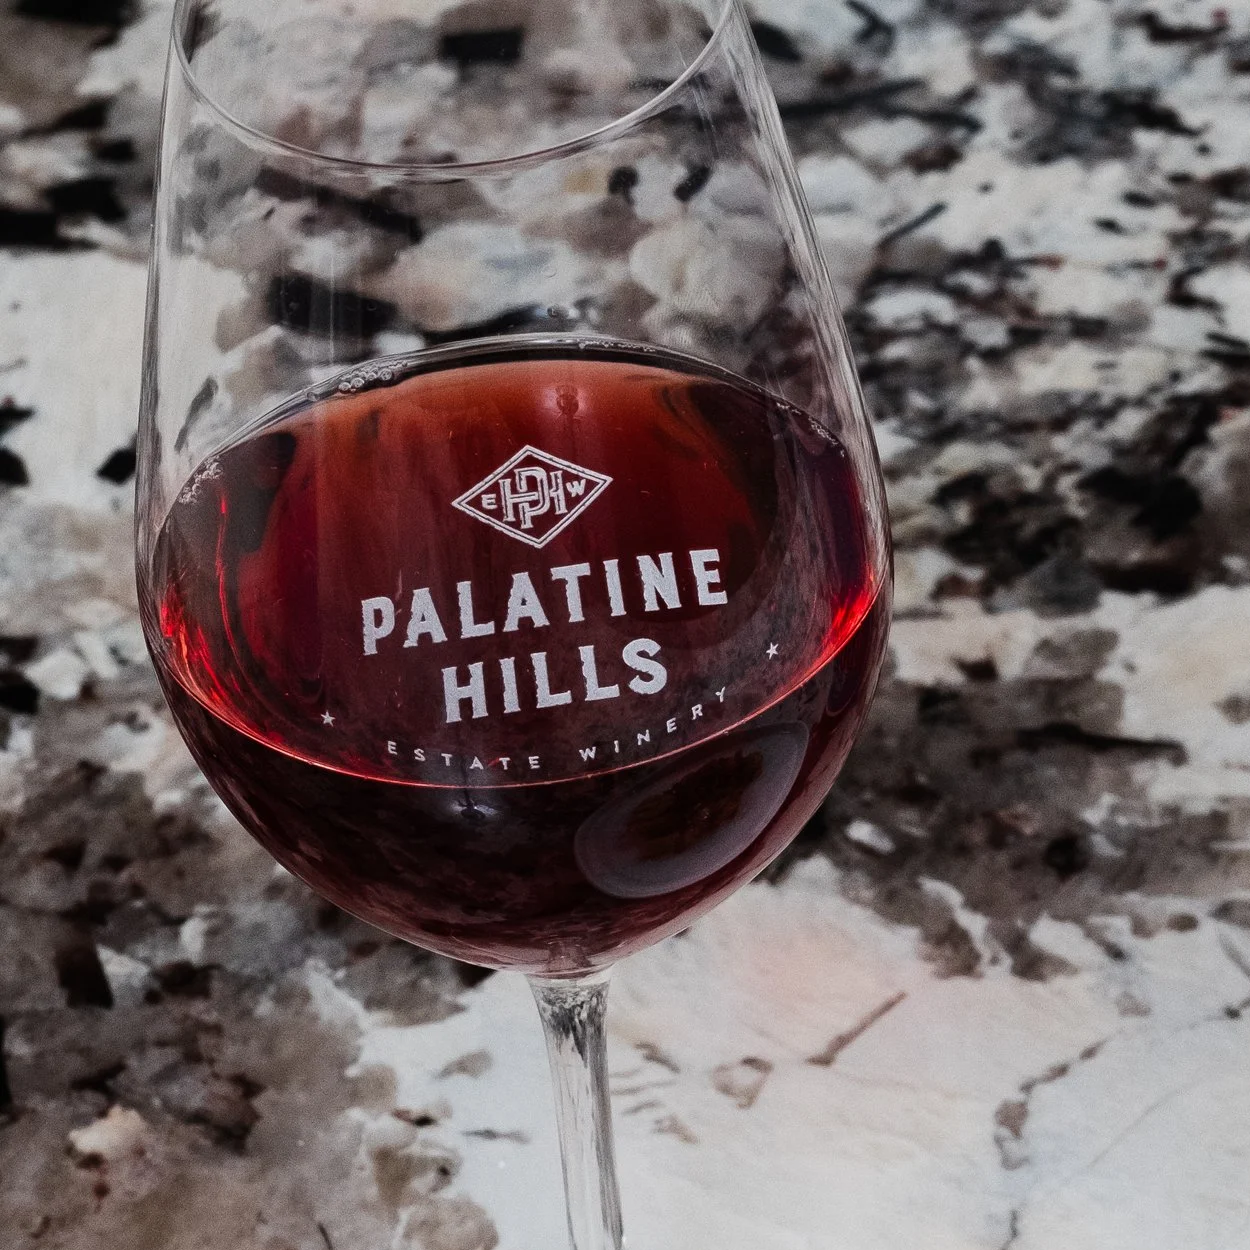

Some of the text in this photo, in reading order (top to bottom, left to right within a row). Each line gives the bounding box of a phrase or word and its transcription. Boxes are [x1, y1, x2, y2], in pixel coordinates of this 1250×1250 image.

[360, 548, 728, 656] PALATINE
[441, 637, 668, 724] HILLS
[386, 686, 727, 771] ESTATE WINERY
